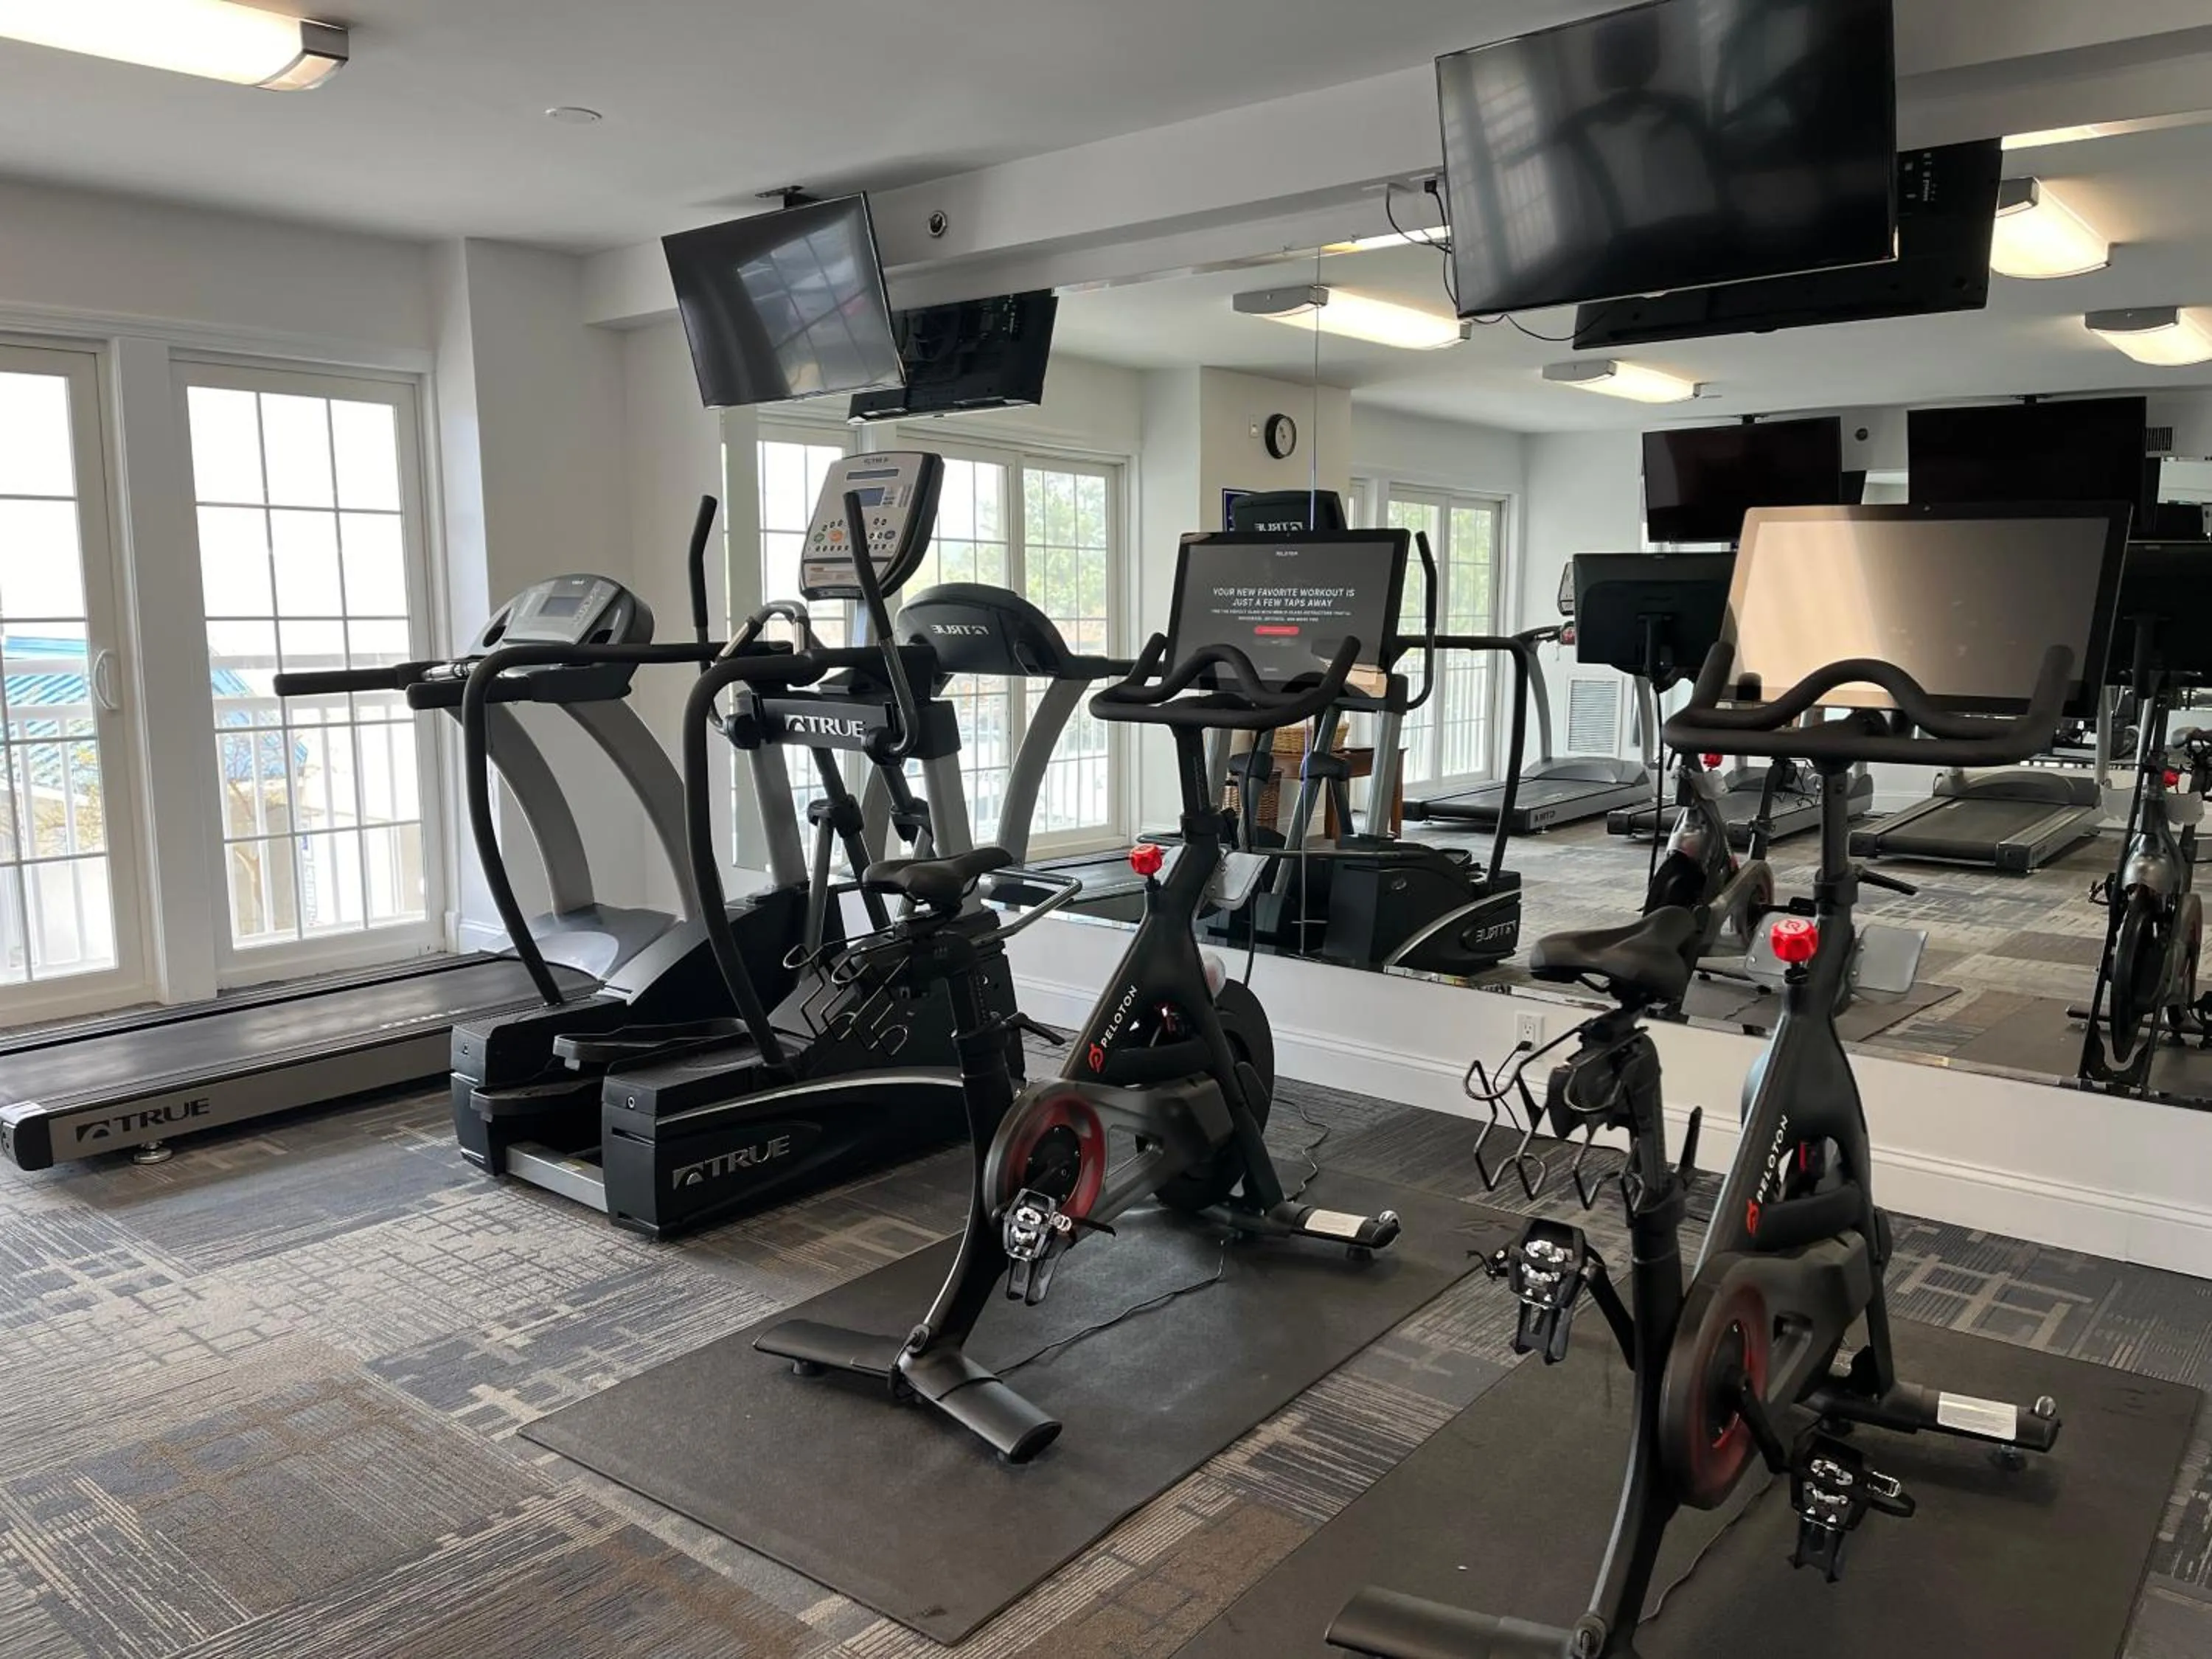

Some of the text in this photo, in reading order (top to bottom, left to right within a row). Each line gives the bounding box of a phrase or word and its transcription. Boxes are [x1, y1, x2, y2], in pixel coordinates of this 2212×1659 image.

[1213, 588, 1355, 597] YOUR NEW FAVORITE WORKOUT IS
[1233, 598, 1333, 607] JUST A FEW TAPS AWAY
[804, 715, 864, 737] TRUE
[1101, 984, 1138, 1048] PELOTON
[113, 1098, 210, 1132] TRUE
[705, 1135, 790, 1178] TRUE
[1756, 1114, 1788, 1203] PELOTON
